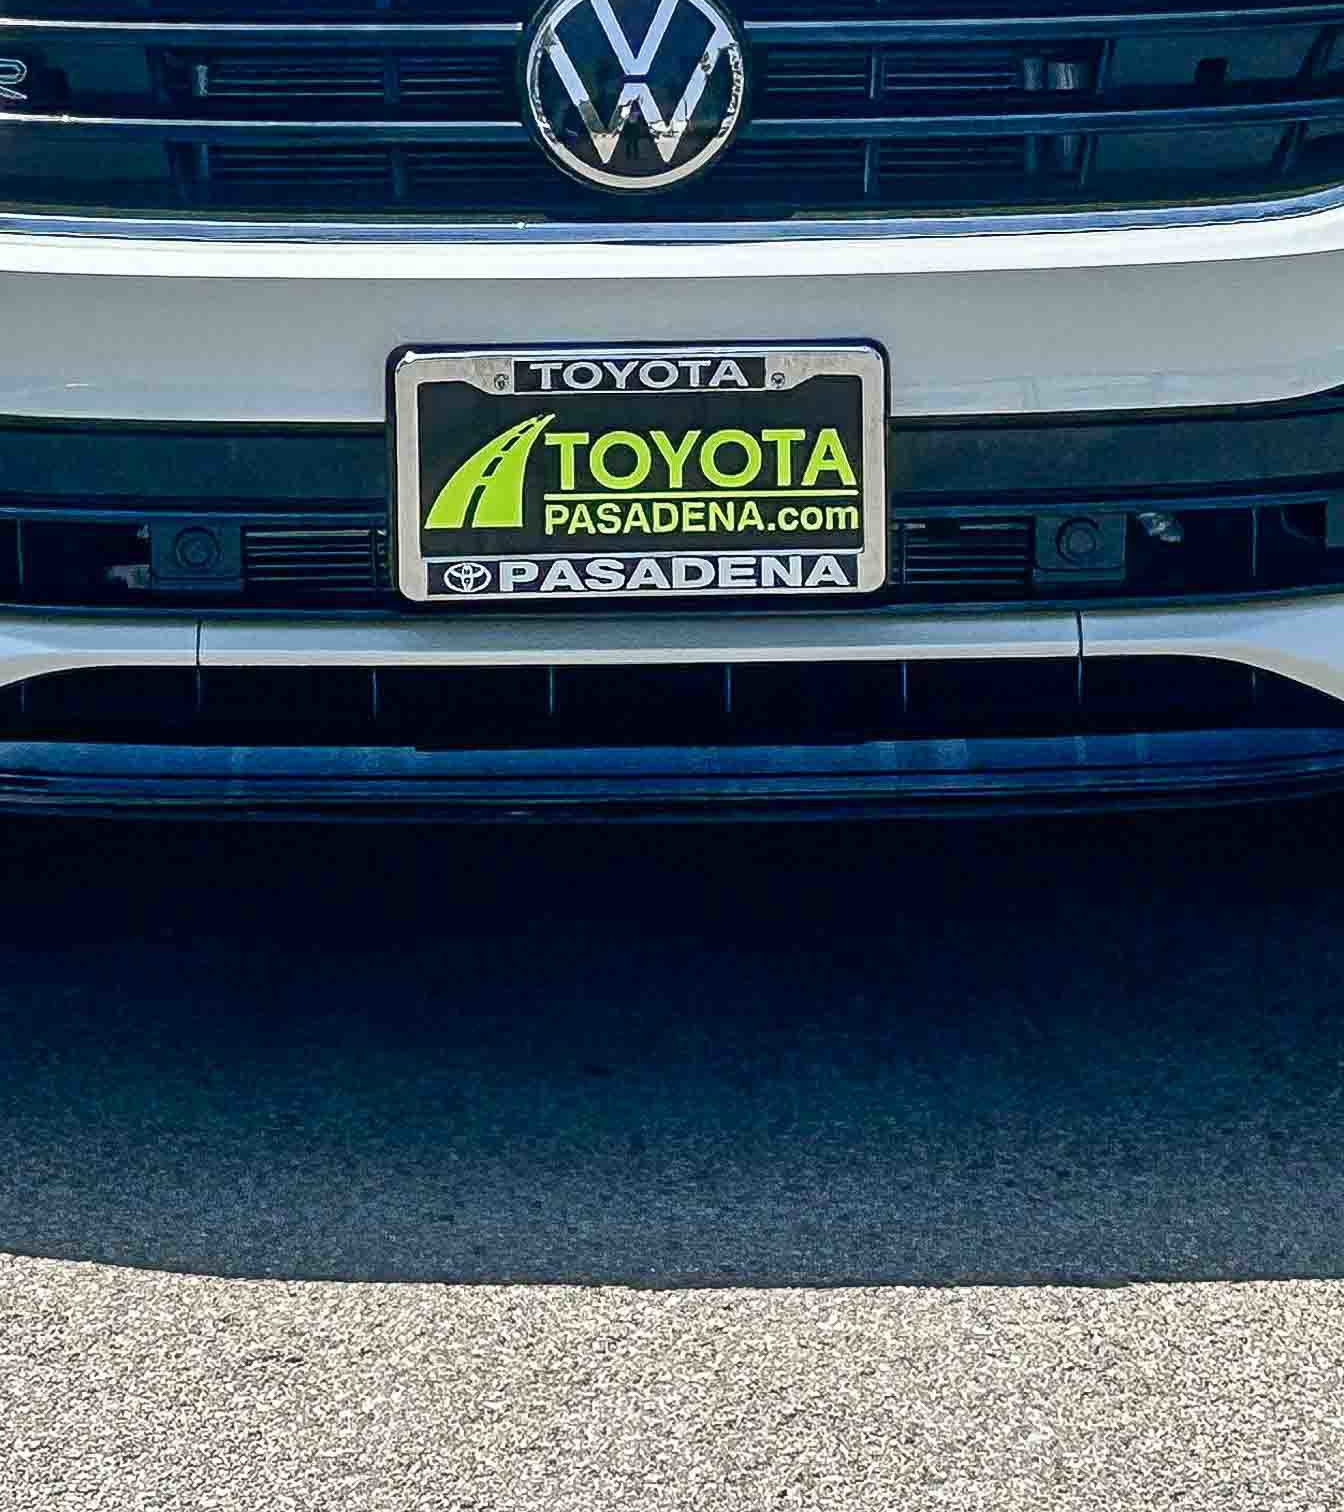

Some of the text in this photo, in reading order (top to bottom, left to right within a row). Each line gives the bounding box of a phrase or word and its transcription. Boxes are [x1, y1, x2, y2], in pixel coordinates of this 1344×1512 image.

[529, 359, 750, 391] TOYOTA
[544, 428, 857, 490] TOYOTA
[544, 501, 860, 536] PASADENA.com
[499, 554, 851, 593] PASADENA
